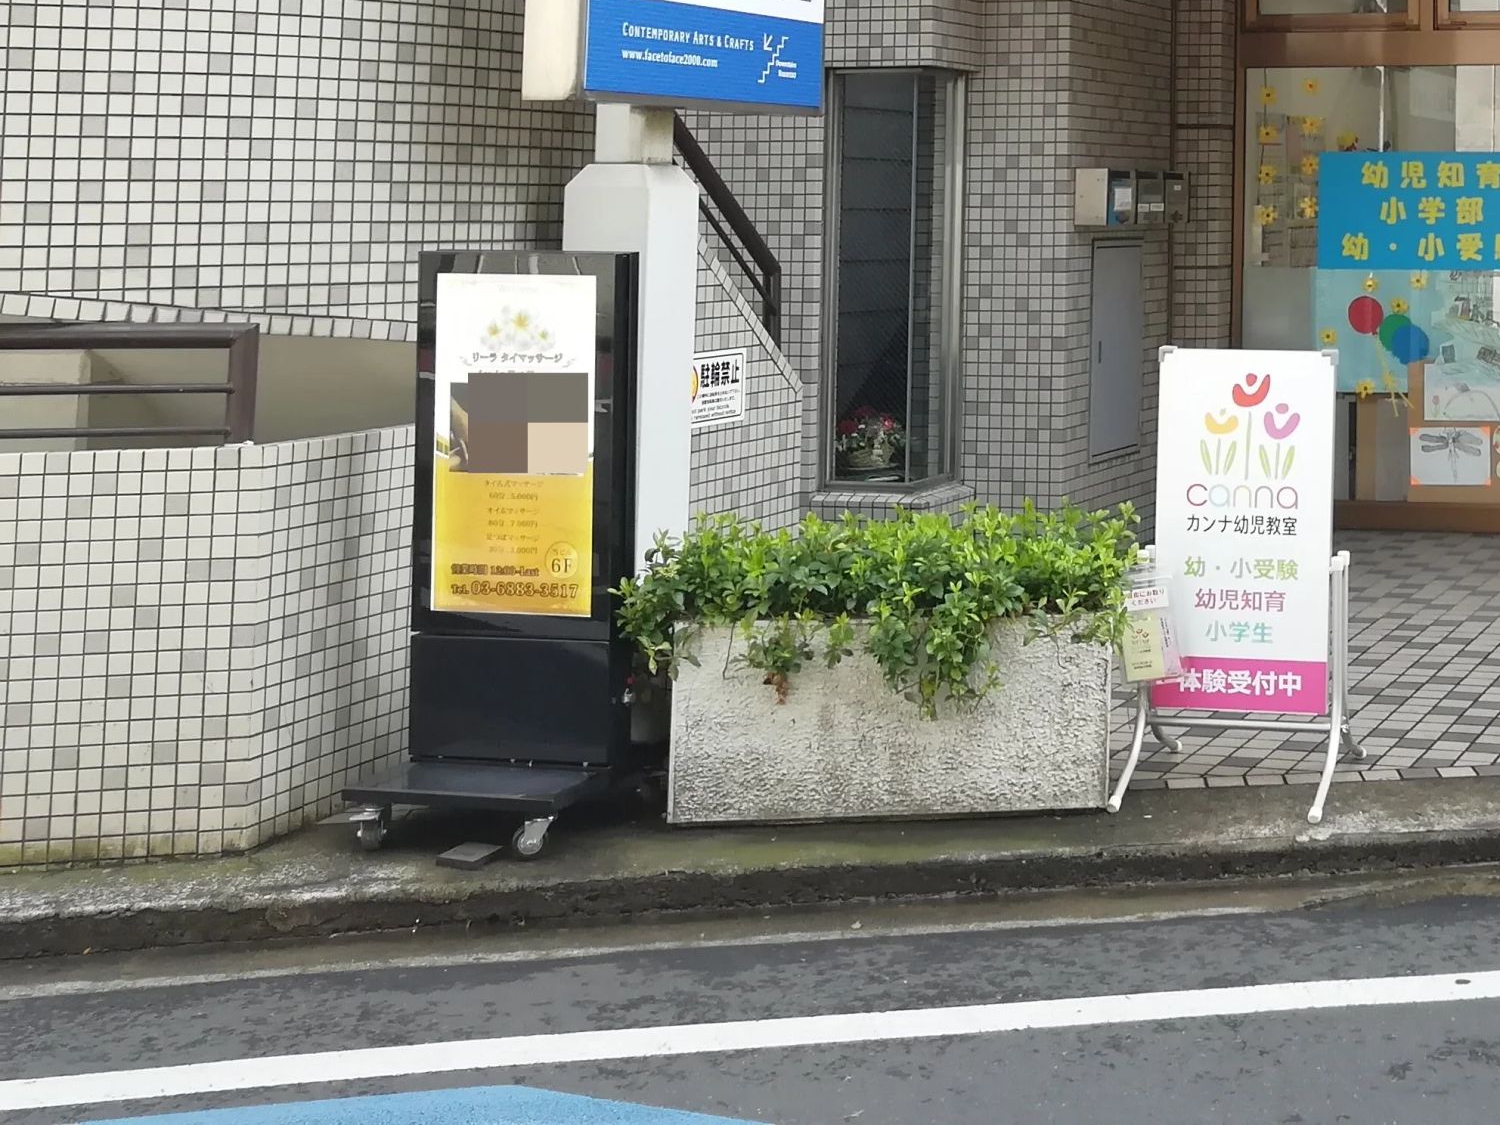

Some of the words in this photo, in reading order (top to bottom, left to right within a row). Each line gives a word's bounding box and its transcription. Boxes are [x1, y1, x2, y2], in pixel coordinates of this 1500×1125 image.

[1379, 195, 1485, 226] 小学部
[472, 352, 498, 363] リーラ
[500, 352, 563, 363] タイマッサージ
[700, 359, 740, 388] 駐輪禁止
[1185, 482, 1299, 510] canna
[1185, 514, 1298, 537] カンナ幼児教室
[551, 558, 573, 574] 6F
[470, 580, 579, 599] 03-6883-3517
[1194, 588, 1287, 613] 幼児知育
[1205, 620, 1273, 644] 小学生
[1178, 668, 1302, 697] 体験受付中
